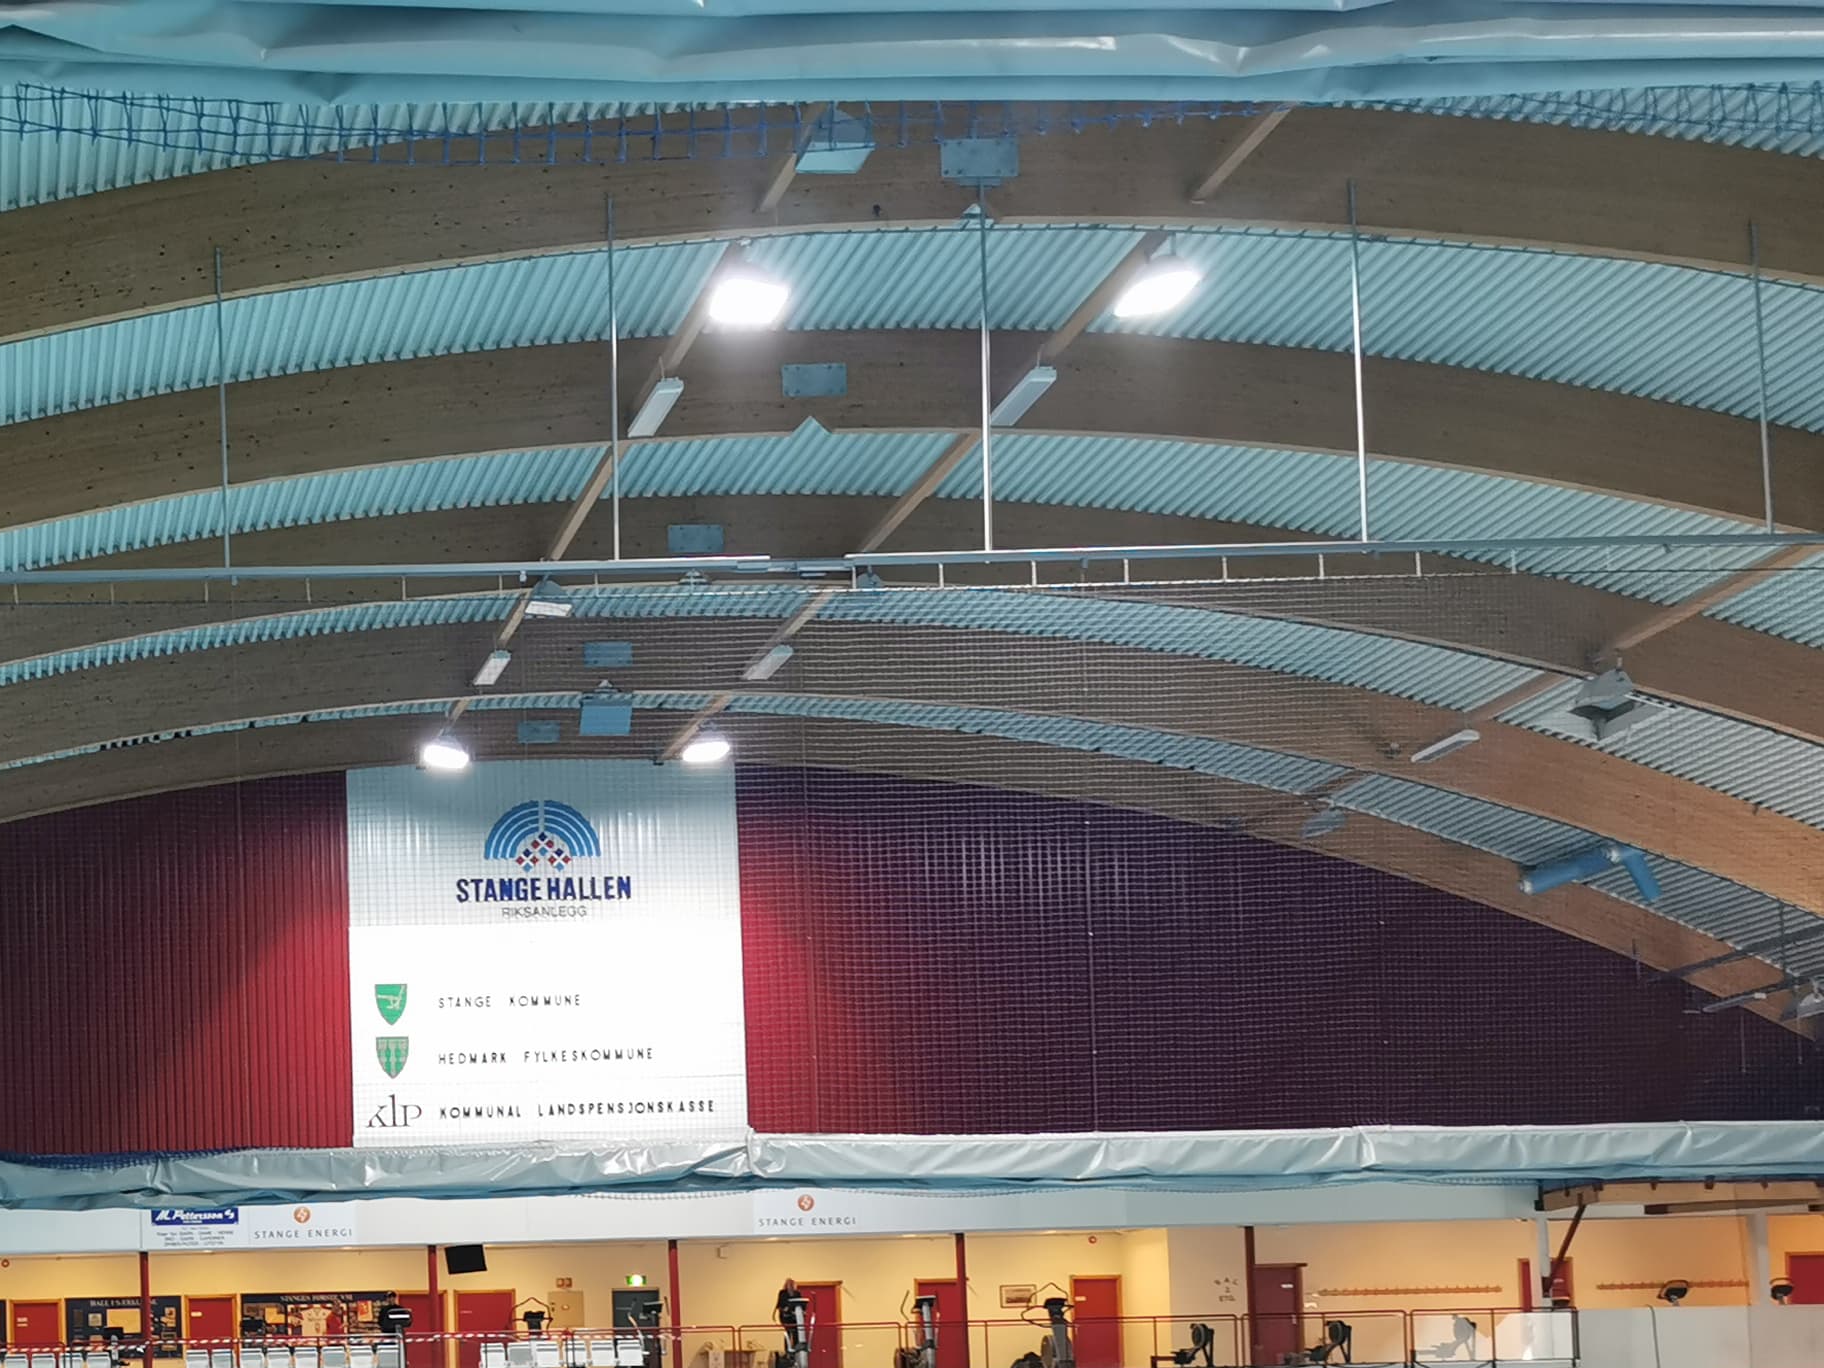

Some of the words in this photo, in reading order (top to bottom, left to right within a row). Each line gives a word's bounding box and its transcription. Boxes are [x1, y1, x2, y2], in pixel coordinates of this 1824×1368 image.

[456, 878, 542, 903] STANGE
[547, 876, 632, 901] HALLEN
[501, 905, 588, 918] RIKSANLEGG
[438, 996, 492, 1009] STANGE
[509, 994, 581, 1007] KOMMUNE
[438, 1052, 507, 1065] HEDMARK
[524, 1048, 653, 1063] FYLKESKOMMUNE
[439, 1104, 522, 1119] KOMMUNAL
[538, 1100, 715, 1117] LANDSPENSJONSKASSE
[759, 1218, 804, 1227] STANGE
[811, 1216, 857, 1226] ENERGI
[254, 1229, 300, 1239] STANGE
[308, 1228, 353, 1238] ENERGI
